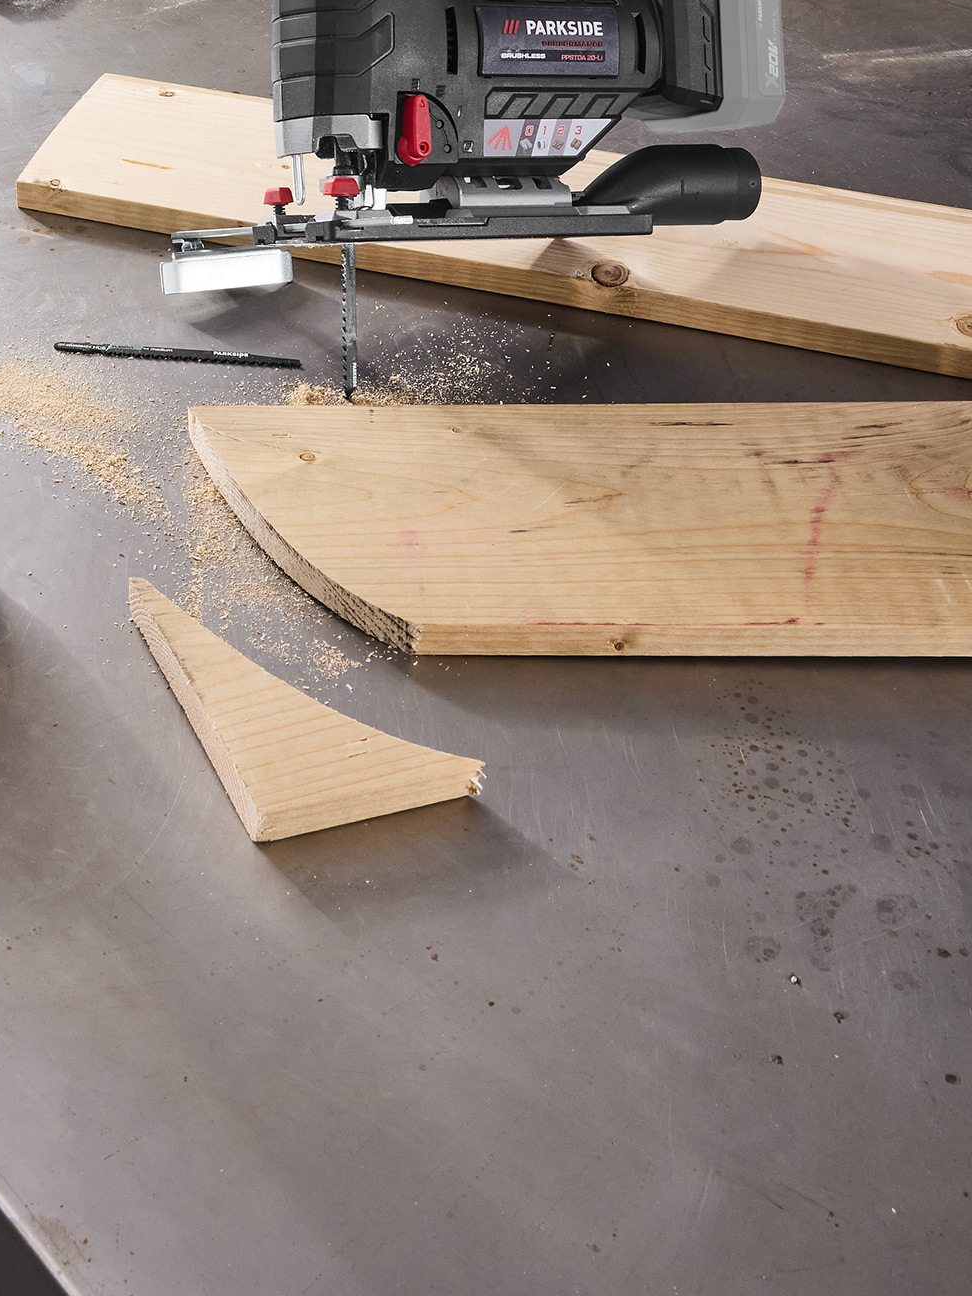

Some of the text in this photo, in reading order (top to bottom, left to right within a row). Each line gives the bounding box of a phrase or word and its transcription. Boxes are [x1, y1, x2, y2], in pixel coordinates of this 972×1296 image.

[525, 20, 604, 36] PARKSIDE
[500, 52, 547, 60] BRUSHLESS
[524, 125, 583, 136] 0 1 2 3
[212, 350, 249, 358] PARKSIDE
